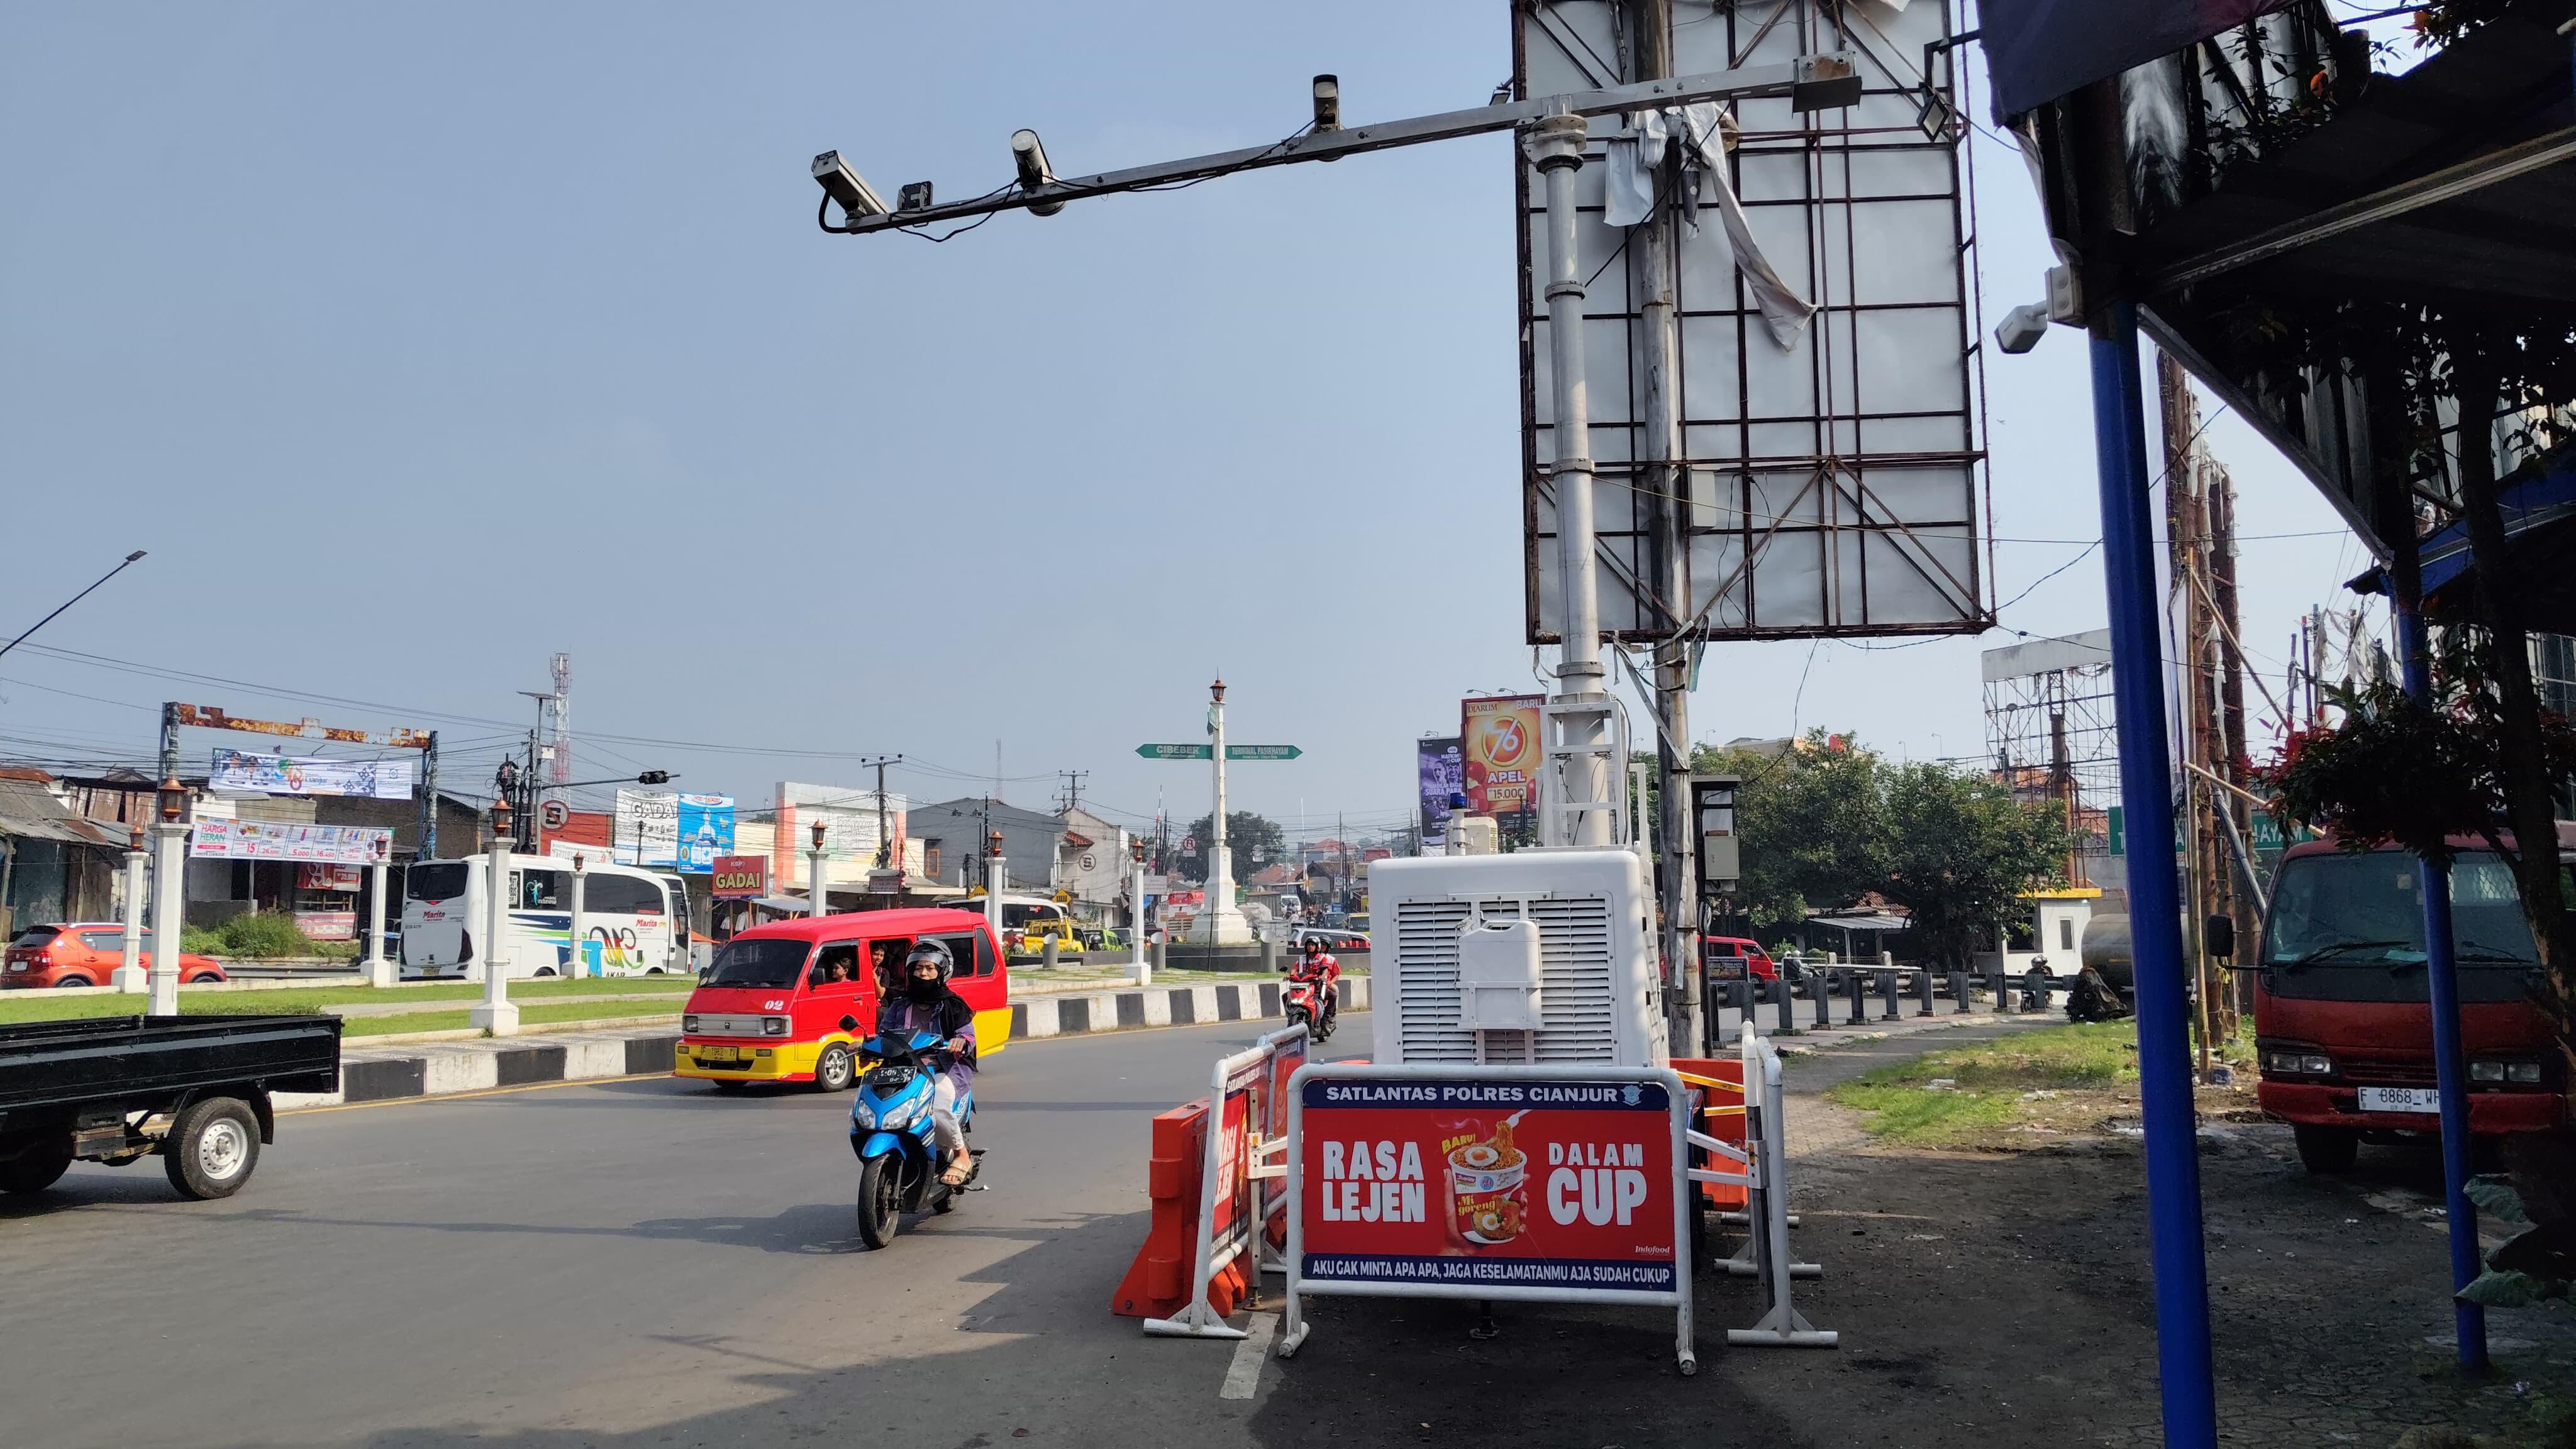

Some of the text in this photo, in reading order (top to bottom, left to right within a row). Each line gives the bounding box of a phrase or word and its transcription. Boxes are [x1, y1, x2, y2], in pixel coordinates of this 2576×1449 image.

[1468, 703, 1497, 714] DJARUM
[1516, 699, 1541, 709] BARU
[1488, 719, 1519, 762] 76
[1231, 747, 1289, 755] TERMINAL PASIRHAYAM
[305, 775, 328, 784] Cianjur
[1487, 769, 1527, 784] APEL
[1425, 787, 1445, 796] SUARA
[1493, 787, 1524, 799] 15.000
[201, 824, 227, 833] HARGA
[200, 833, 226, 841] HERAN
[247, 842, 256, 853] 15
[715, 872, 760, 889] GADAI
[423, 911, 445, 919] Marita
[635, 919, 657, 927] Marita
[764, 1000, 784, 1011] 02
[1326, 1087, 1618, 1102] SATLANTAS POLRES CIANJUR
[2360, 1089, 2367, 1102] F
[1441, 1133, 1476, 1155] BARU!
[1323, 1140, 1424, 1180] RASA
[1548, 1142, 1643, 1167] DALAM
[1323, 1181, 1426, 1222] LEJEN
[1458, 1195, 1474, 1206] Mi
[1546, 1167, 1647, 1226] CUP
[1458, 1200, 1496, 1216] goreng
[1635, 1245, 1670, 1256] Indofood
[1313, 1260, 1670, 1284] AKU GAK MINTA APA APA, JAGA KESELAMATANMU AJA SUDAH CUKUP
